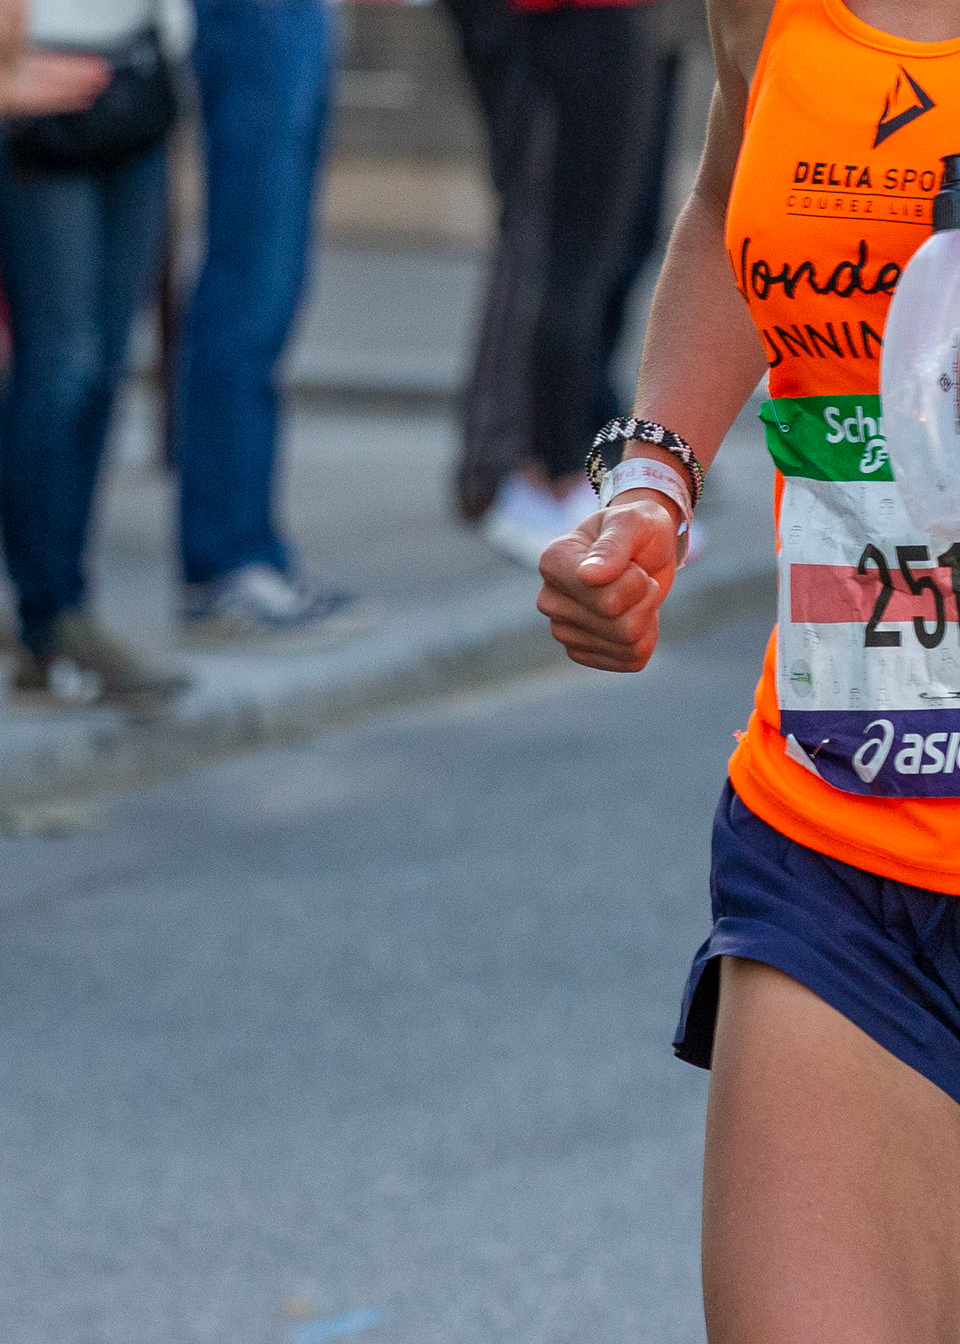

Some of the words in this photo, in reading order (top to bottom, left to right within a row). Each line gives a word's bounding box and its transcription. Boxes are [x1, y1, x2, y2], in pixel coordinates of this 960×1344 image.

[793, 160, 873, 189] DELTA
[883, 167, 937, 193] SPO
[786, 194, 874, 214] COUREZ
[888, 201, 934, 218] LIB
[823, 405, 884, 444] Sch
